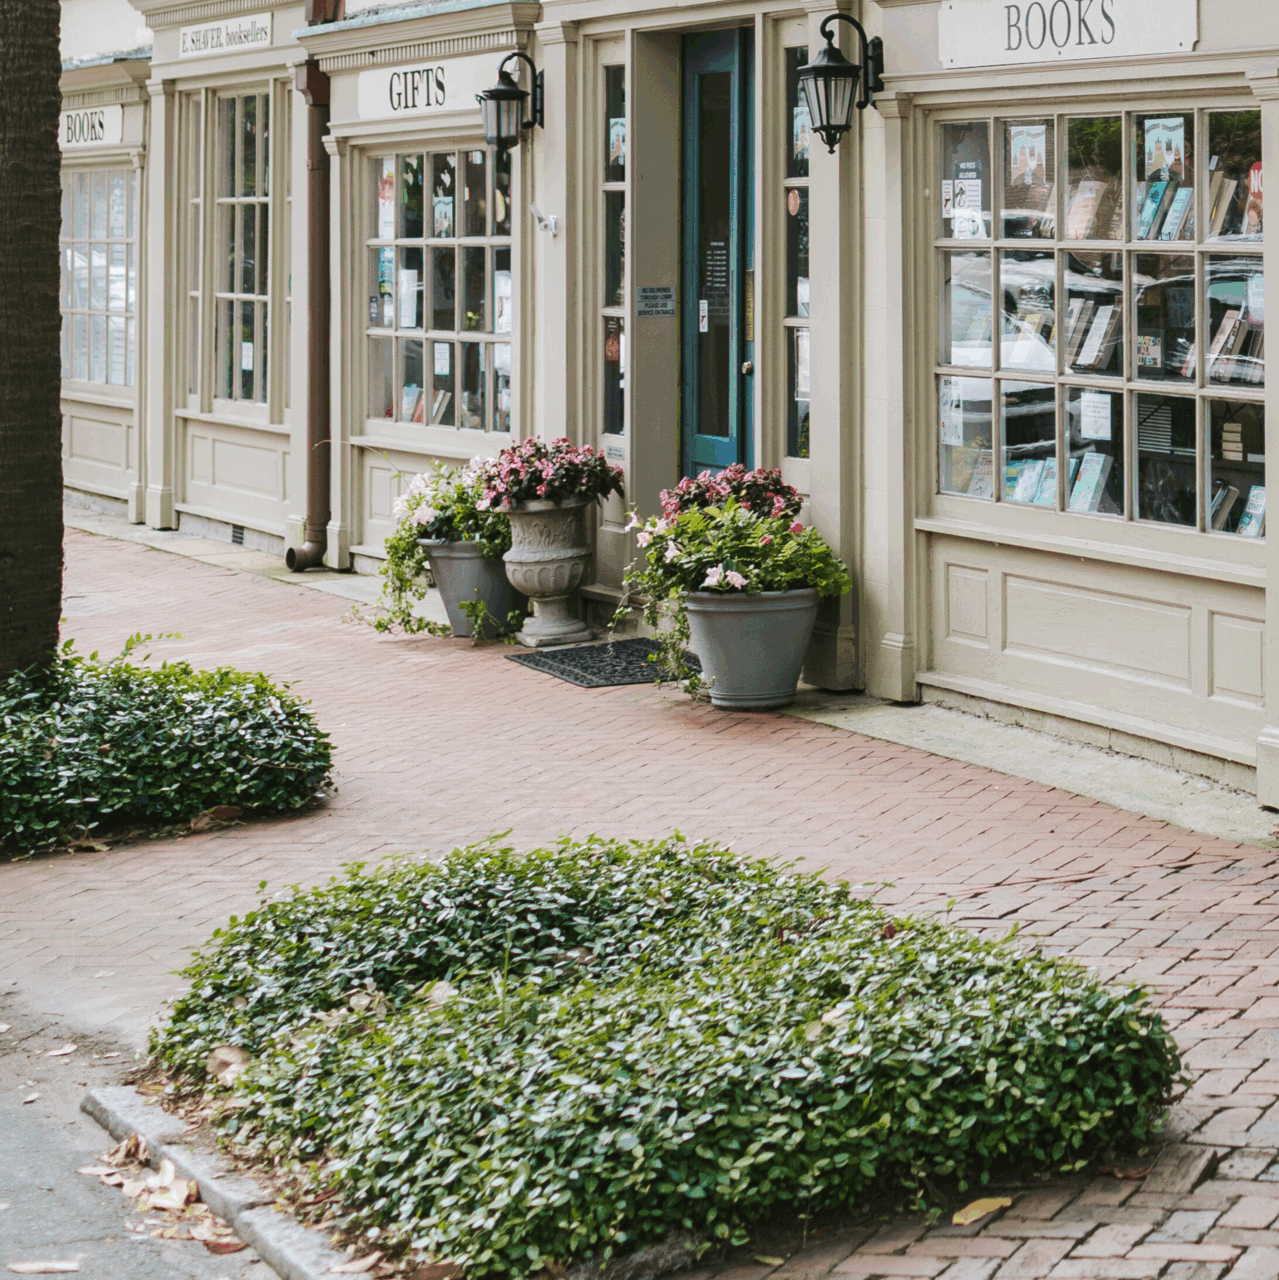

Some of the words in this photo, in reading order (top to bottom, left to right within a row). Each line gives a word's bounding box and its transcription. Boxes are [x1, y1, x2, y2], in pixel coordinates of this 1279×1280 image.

[190, 27, 224, 52] SHAVER,
[225, 21, 269, 46] booksellers
[389, 66, 446, 111] GIFTS
[66, 110, 105, 144] BOOKS
[959, 162, 966, 170] NO
[966, 162, 977, 170] PETS
